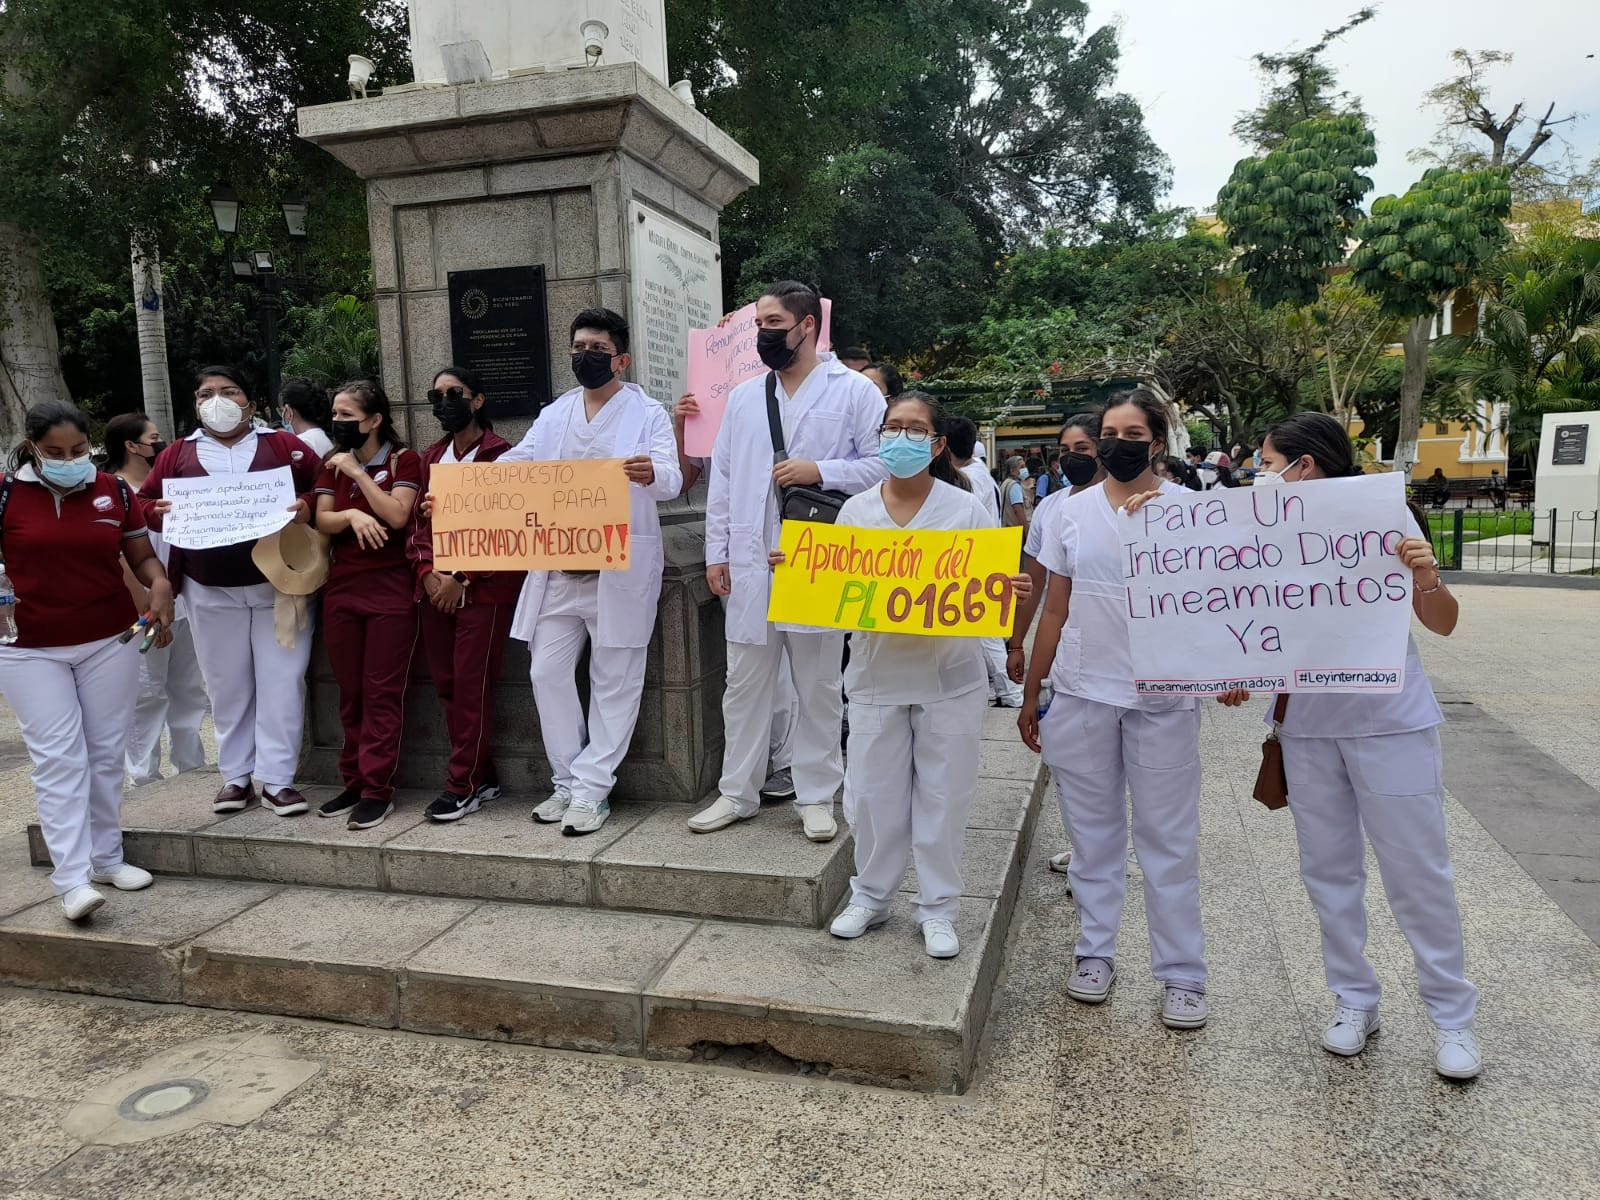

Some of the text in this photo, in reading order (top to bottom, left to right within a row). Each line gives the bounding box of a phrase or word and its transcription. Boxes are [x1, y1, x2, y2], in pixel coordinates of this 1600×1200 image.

[274, 476, 286, 487] de
[461, 465, 574, 488] PRESUPUESTO
[442, 486, 608, 515] ADECUADO PARA
[1142, 489, 1304, 537] Para Un
[525, 512, 543, 527] EL
[433, 528, 527, 558] INTERNADO
[789, 527, 975, 584] Aprobación del
[1123, 529, 1404, 579] Internado Digno
[834, 573, 1013, 629] PL 01669
[1126, 573, 1407, 619] Lineamientos
[1225, 620, 1283, 655] Ya
[1298, 670, 1398, 685] #Leyinternadoya
